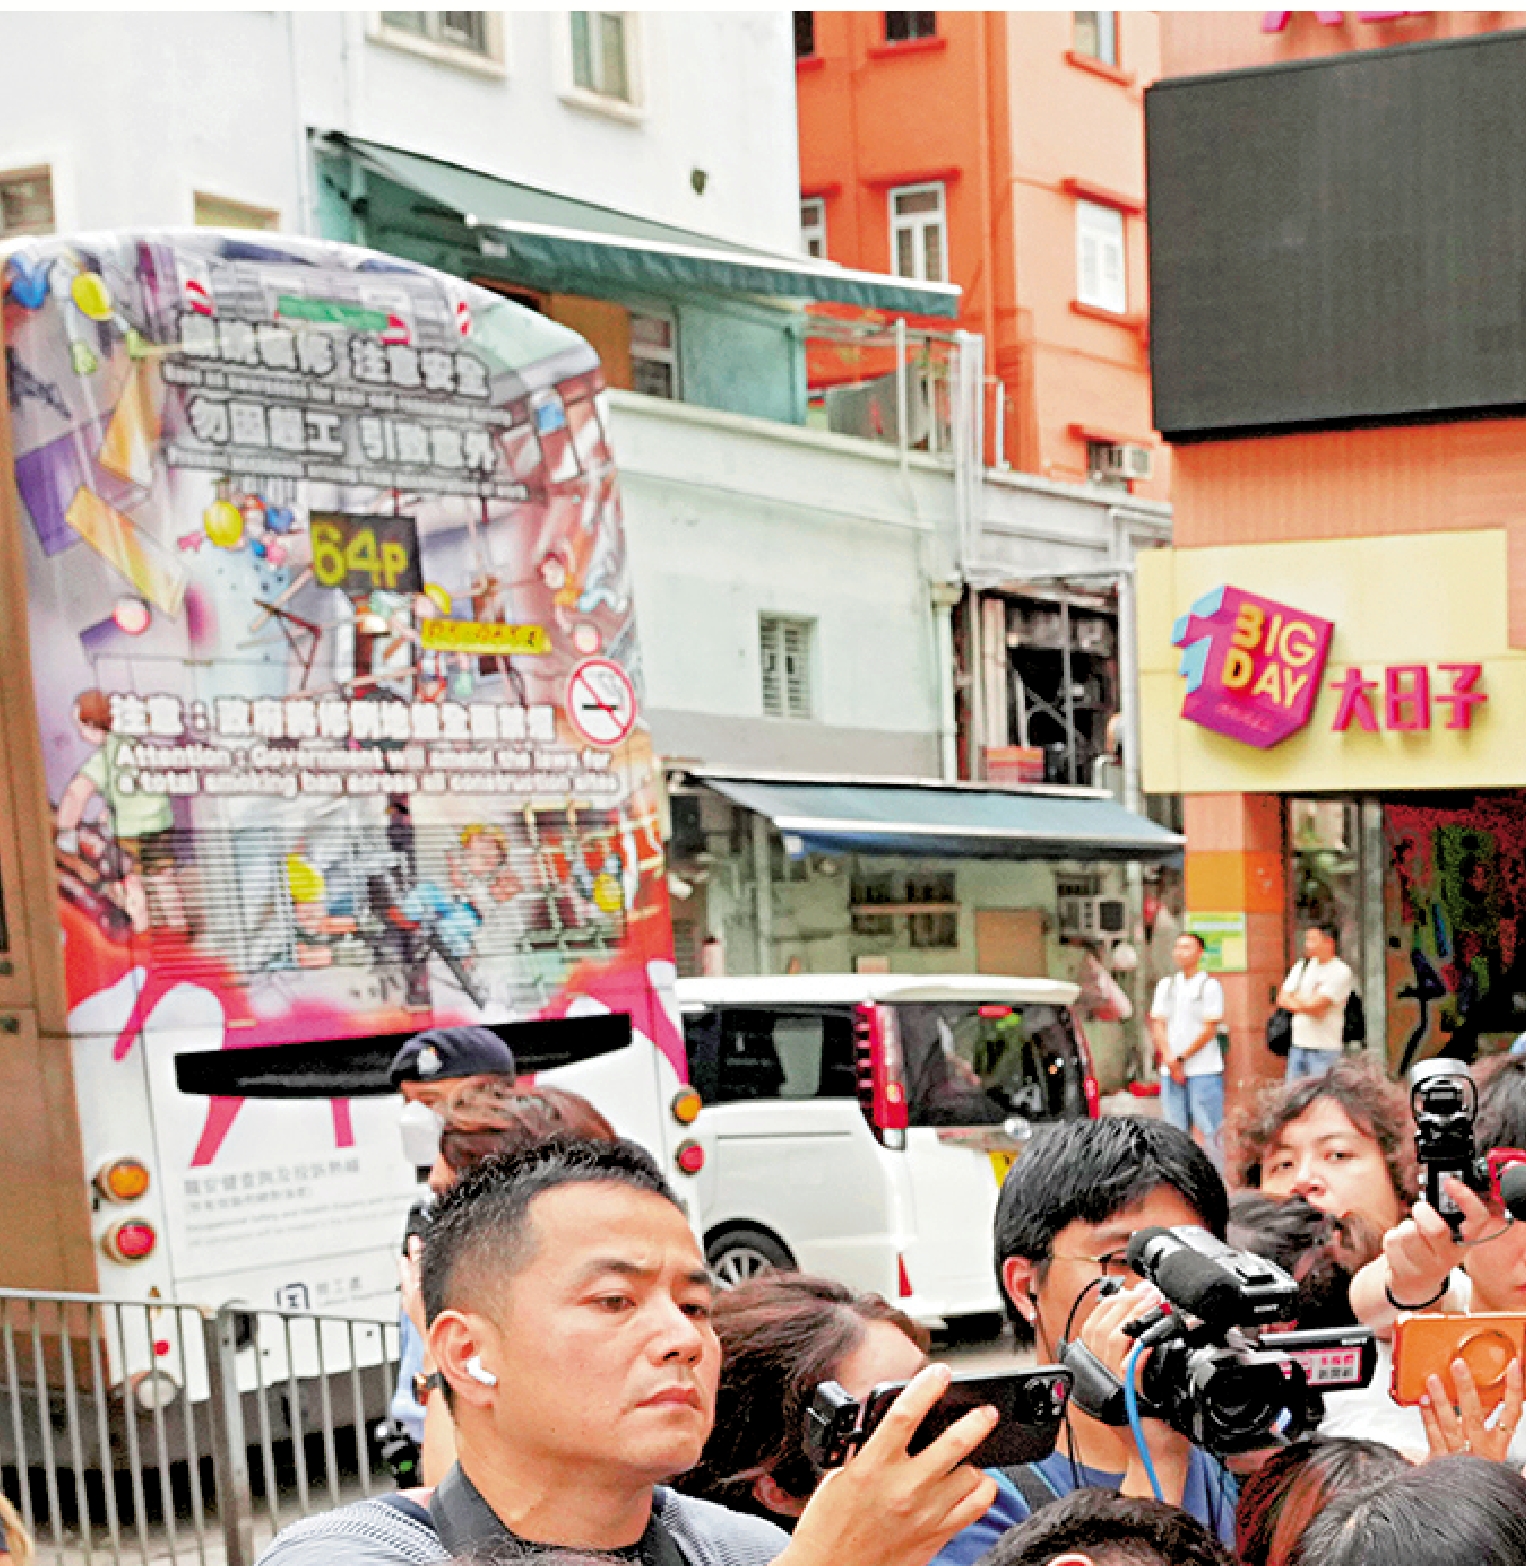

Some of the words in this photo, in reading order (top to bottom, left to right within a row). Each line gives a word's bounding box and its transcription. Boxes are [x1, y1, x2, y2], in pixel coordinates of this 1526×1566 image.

[312, 521, 410, 589] 64P
[1230, 602, 1318, 667] BIG
[1221, 648, 1308, 708] DAY
[1328, 660, 1489, 733] 大日子
